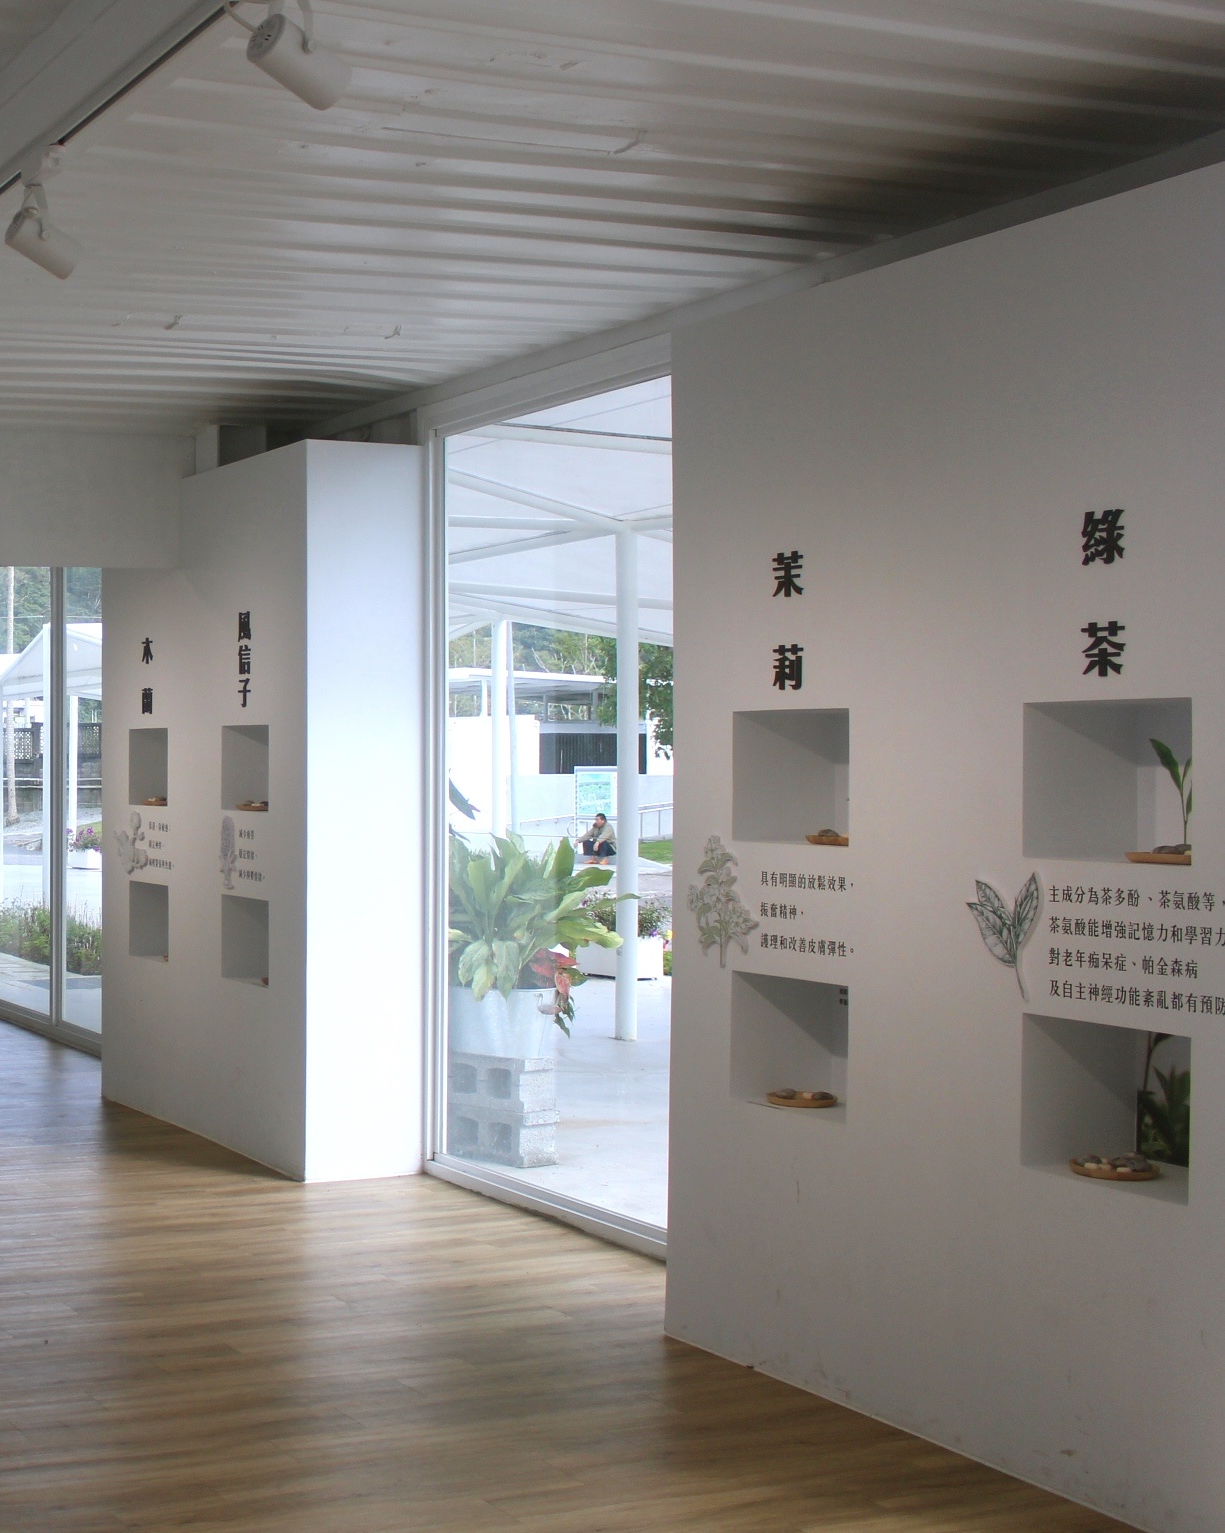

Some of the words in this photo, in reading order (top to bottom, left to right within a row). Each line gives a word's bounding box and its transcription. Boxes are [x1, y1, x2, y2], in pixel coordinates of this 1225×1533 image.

[238, 611, 251, 707] 風信子
[772, 550, 804, 690] 茉莉
[1081, 508, 1126, 677] 綠茶
